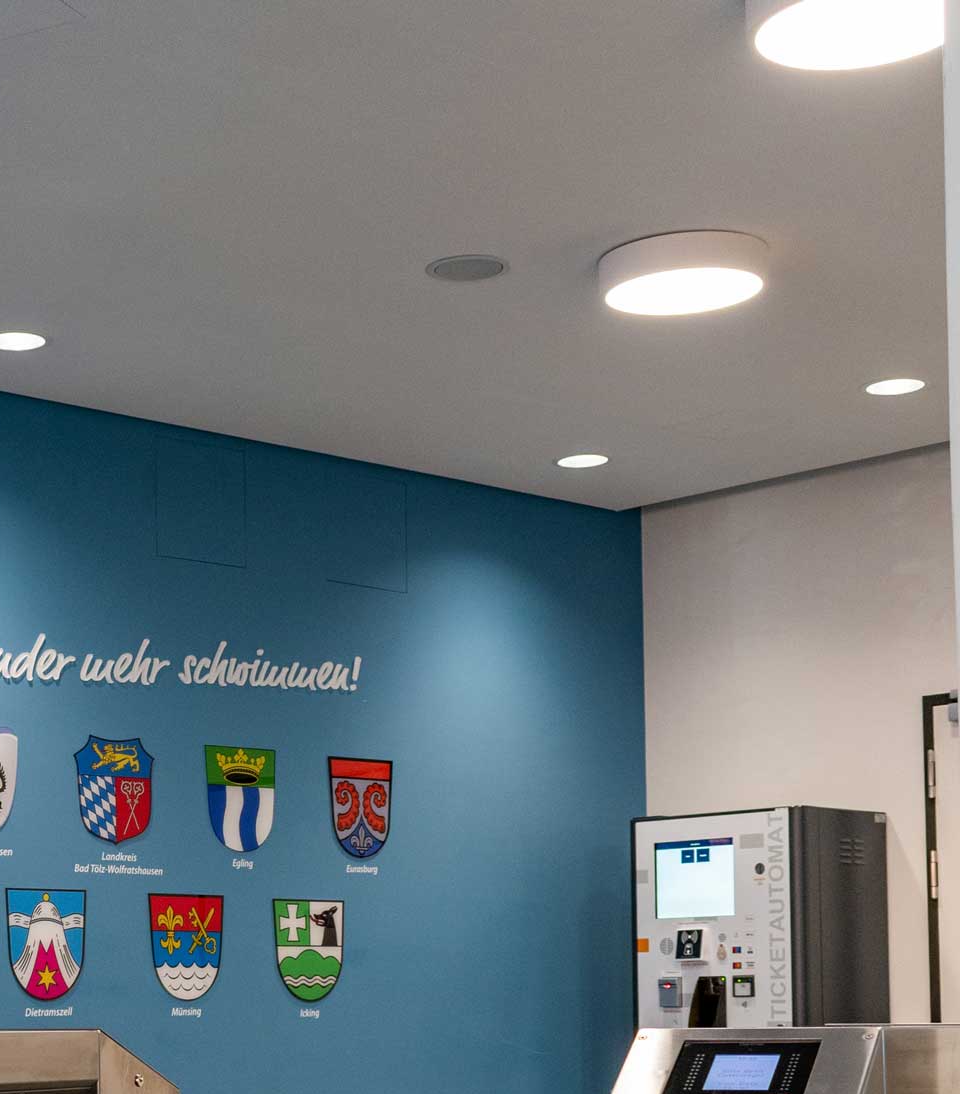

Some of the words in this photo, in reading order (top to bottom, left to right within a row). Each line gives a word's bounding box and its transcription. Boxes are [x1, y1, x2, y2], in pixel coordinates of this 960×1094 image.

[79, 638, 171, 686] mehr
[178, 640, 362, 692] schwimmen!
[101, 851, 138, 862] Landkreis
[74, 863, 89, 873] Bad
[90, 863, 164, 876] Tölz-Wolfratshausen
[232, 858, 254, 870] Egling
[345, 864, 379, 876] Eurasburg
[768, 813, 786, 1019] TICKETAUTOMAT
[24, 1006, 73, 1017] Dietramszell
[171, 1007, 202, 1018] Münsing
[299, 1008, 320, 1019] Icking
